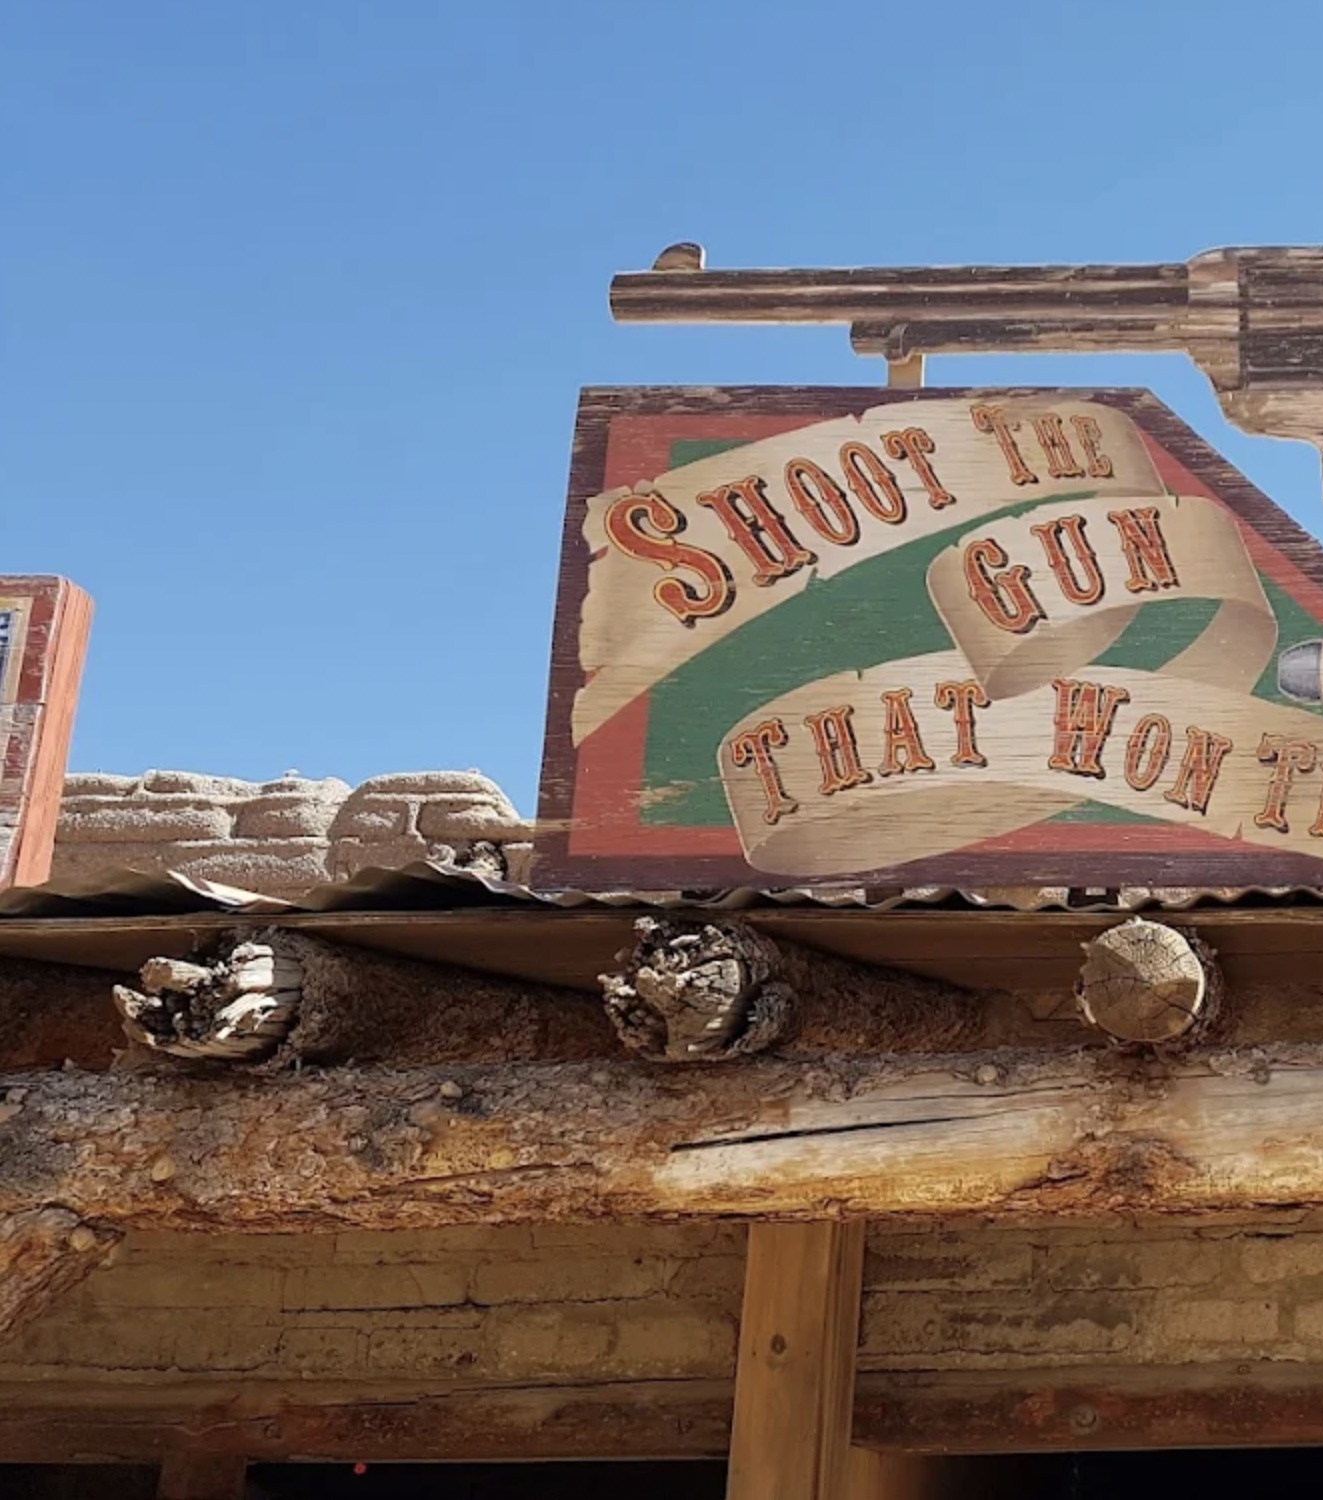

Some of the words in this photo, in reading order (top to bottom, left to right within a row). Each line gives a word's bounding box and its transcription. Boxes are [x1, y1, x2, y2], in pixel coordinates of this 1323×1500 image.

[604, 427, 956, 627] SHOOT
[971, 403, 1113, 484] THE
[963, 506, 1180, 632] GUN
[731, 680, 991, 824] THAT
[1049, 679, 1234, 815] WON
